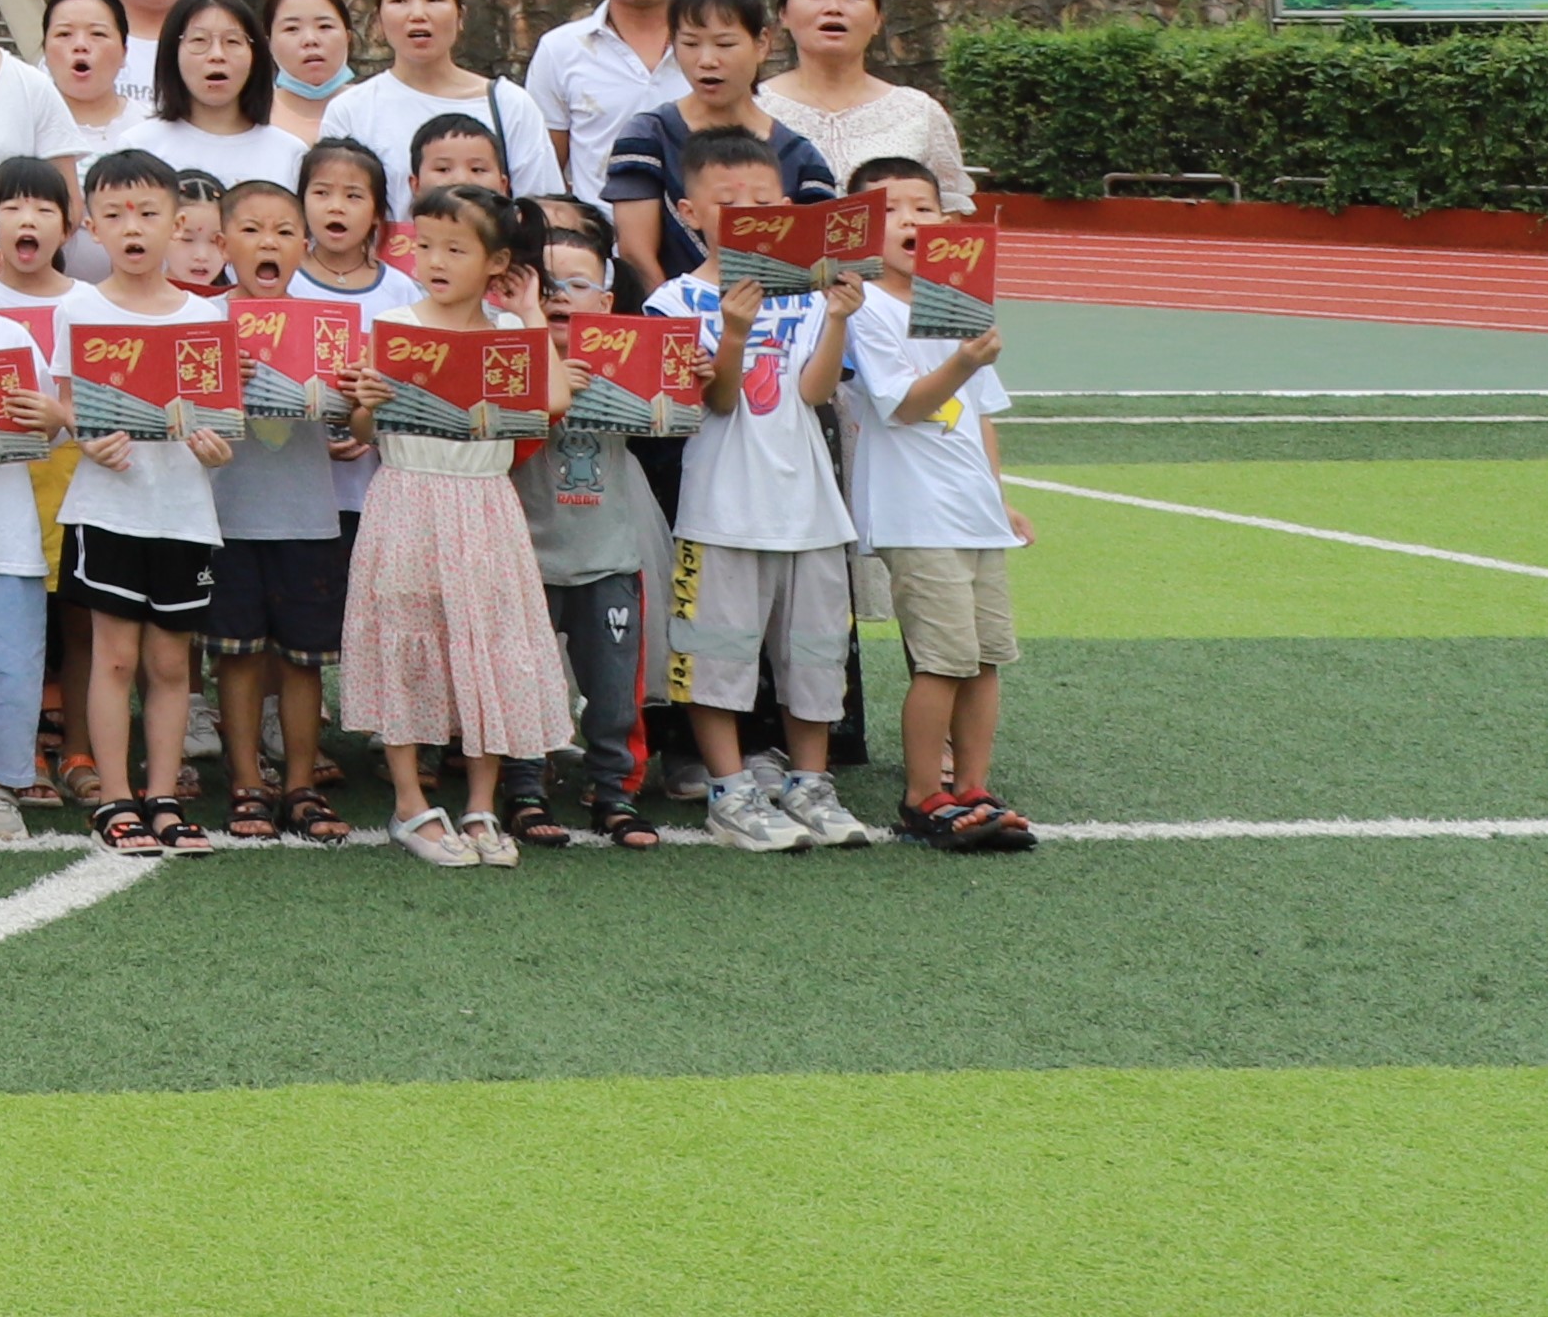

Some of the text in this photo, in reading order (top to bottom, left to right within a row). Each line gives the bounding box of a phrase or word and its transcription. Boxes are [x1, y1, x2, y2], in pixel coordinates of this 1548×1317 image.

[83, 337, 145, 374] 2021
[387, 335, 451, 376] 2021
[580, 325, 638, 365] 2021
